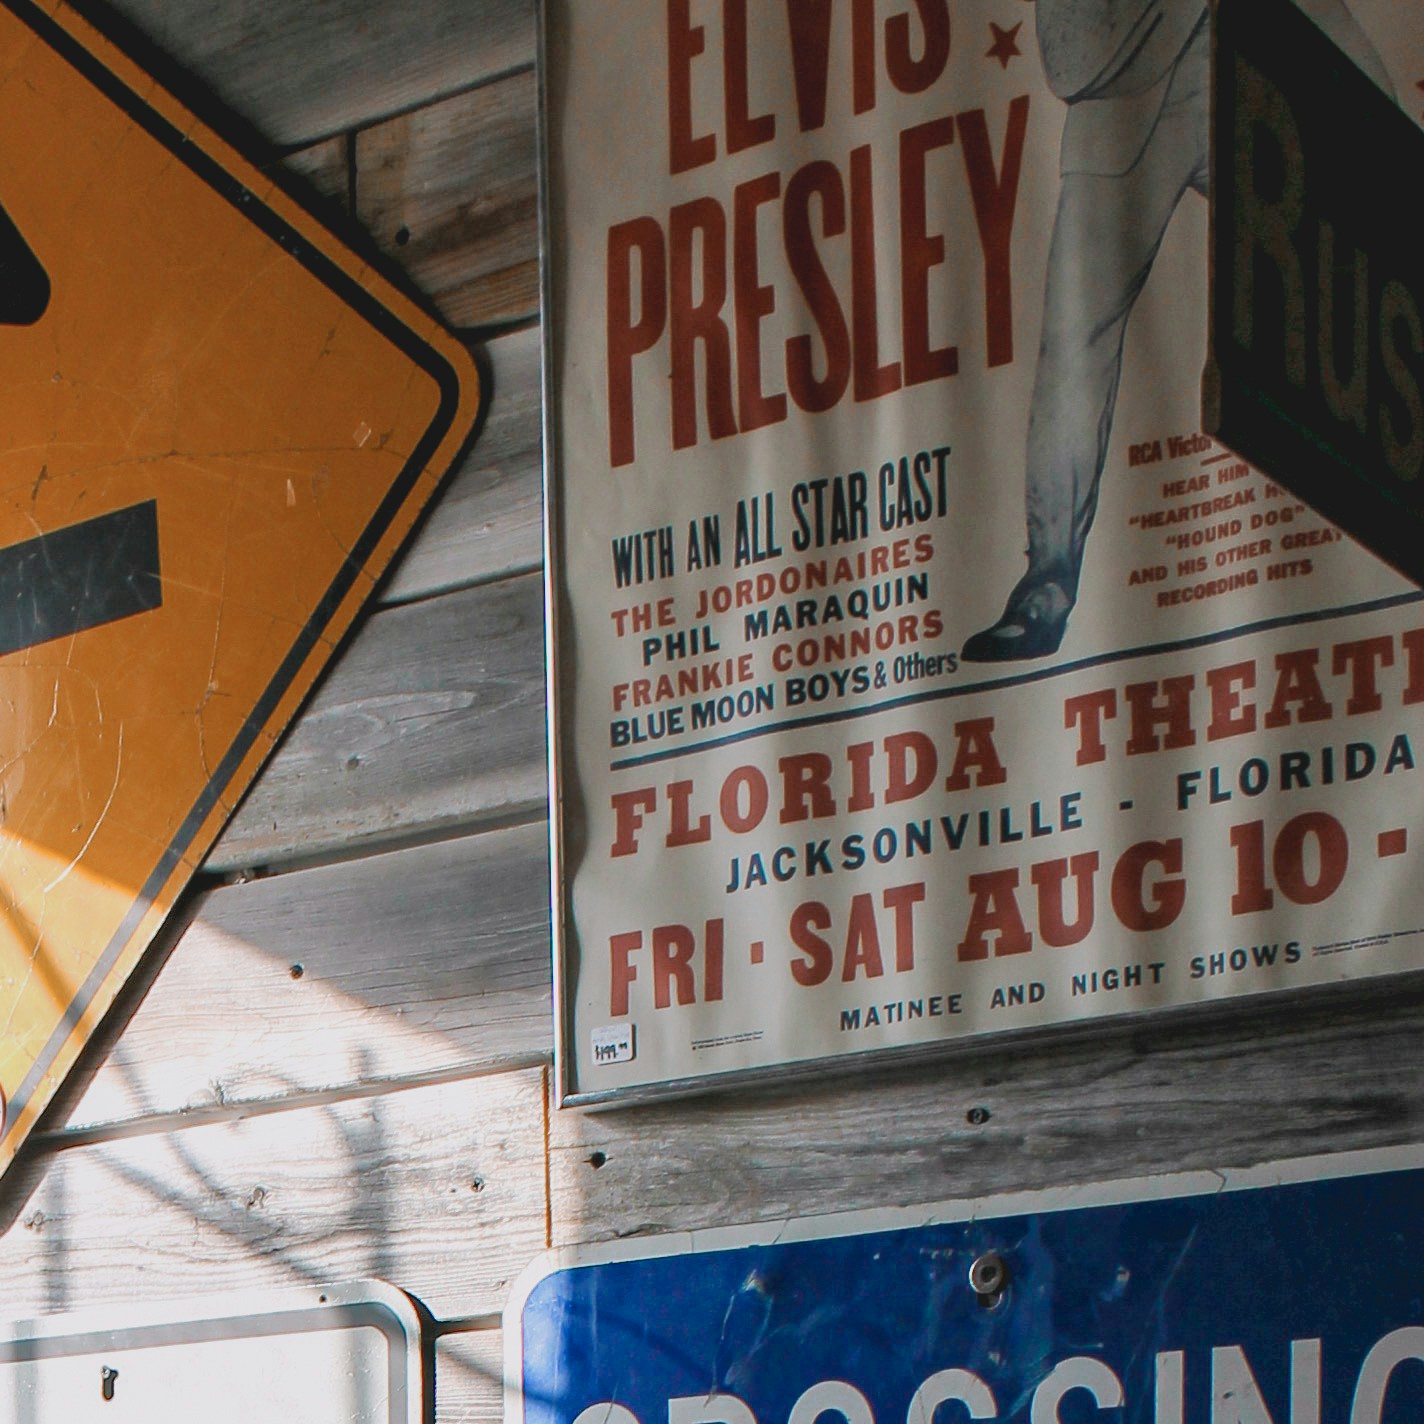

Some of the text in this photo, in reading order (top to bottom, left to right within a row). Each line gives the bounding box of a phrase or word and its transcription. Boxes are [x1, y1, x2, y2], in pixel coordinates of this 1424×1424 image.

[608, 95, 1029, 468] PRESLEY
[1128, 443, 1162, 467] RCA
[1163, 464, 1249, 498] HEAR HIM
[611, 446, 951, 589] WITH AN ALL STAR CAST
[1129, 565, 1168, 586] AND
[1178, 556, 1208, 577] HIS
[1216, 539, 1272, 566] OTHER
[611, 533, 935, 637] THE JORDONAIRES
[643, 572, 929, 666] PHIL MARAQUIN
[1157, 559, 1314, 608] RECORDING HITS
[610, 651, 958, 748] BLUE MOON BOYS & Others
[612, 609, 944, 711] FRANKIE CONNORS
[609, 716, 1007, 859] FLORIDA
[725, 733, 1417, 894] JACKSONVILLE FLORIDA
[609, 810, 1350, 1017] FRI SAT AUG 10
[839, 994, 963, 1032] MATINEE
[990, 981, 1046, 1010] AND
[1071, 962, 1166, 998] NIGHT
[1190, 940, 1303, 980] SHOWS
